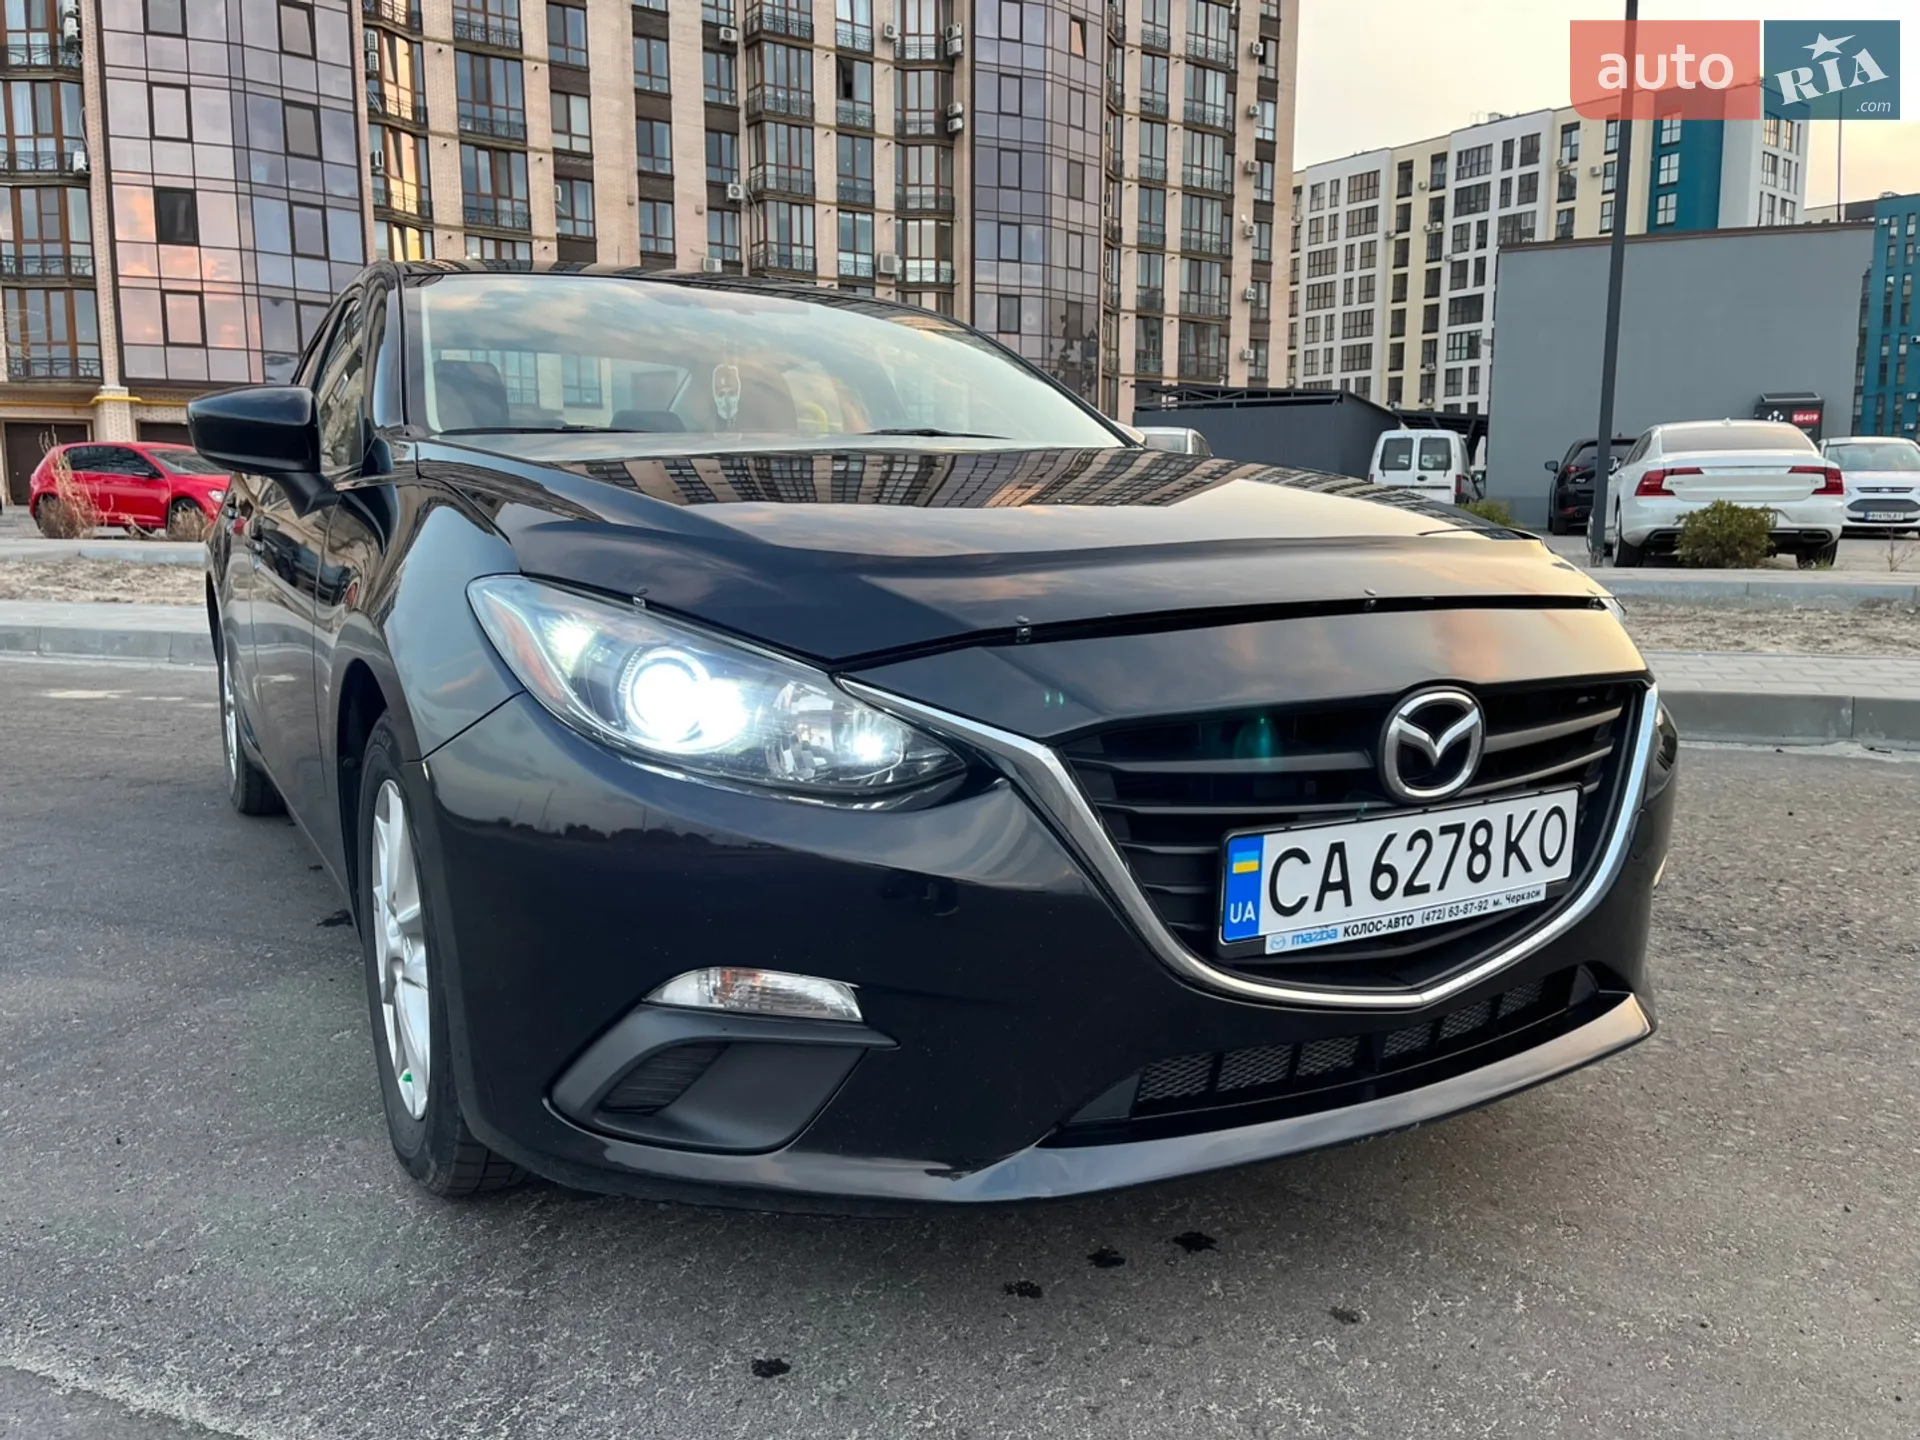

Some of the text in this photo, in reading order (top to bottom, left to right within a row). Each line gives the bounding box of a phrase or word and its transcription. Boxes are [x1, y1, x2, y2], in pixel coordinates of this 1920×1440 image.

[1269, 805, 1568, 917] CA 6278 KO
[1229, 901, 1256, 924] UA
[1291, 888, 1541, 946] mazda КОЛОС-АВТО (472) 63-87-92 м. Черкаси
